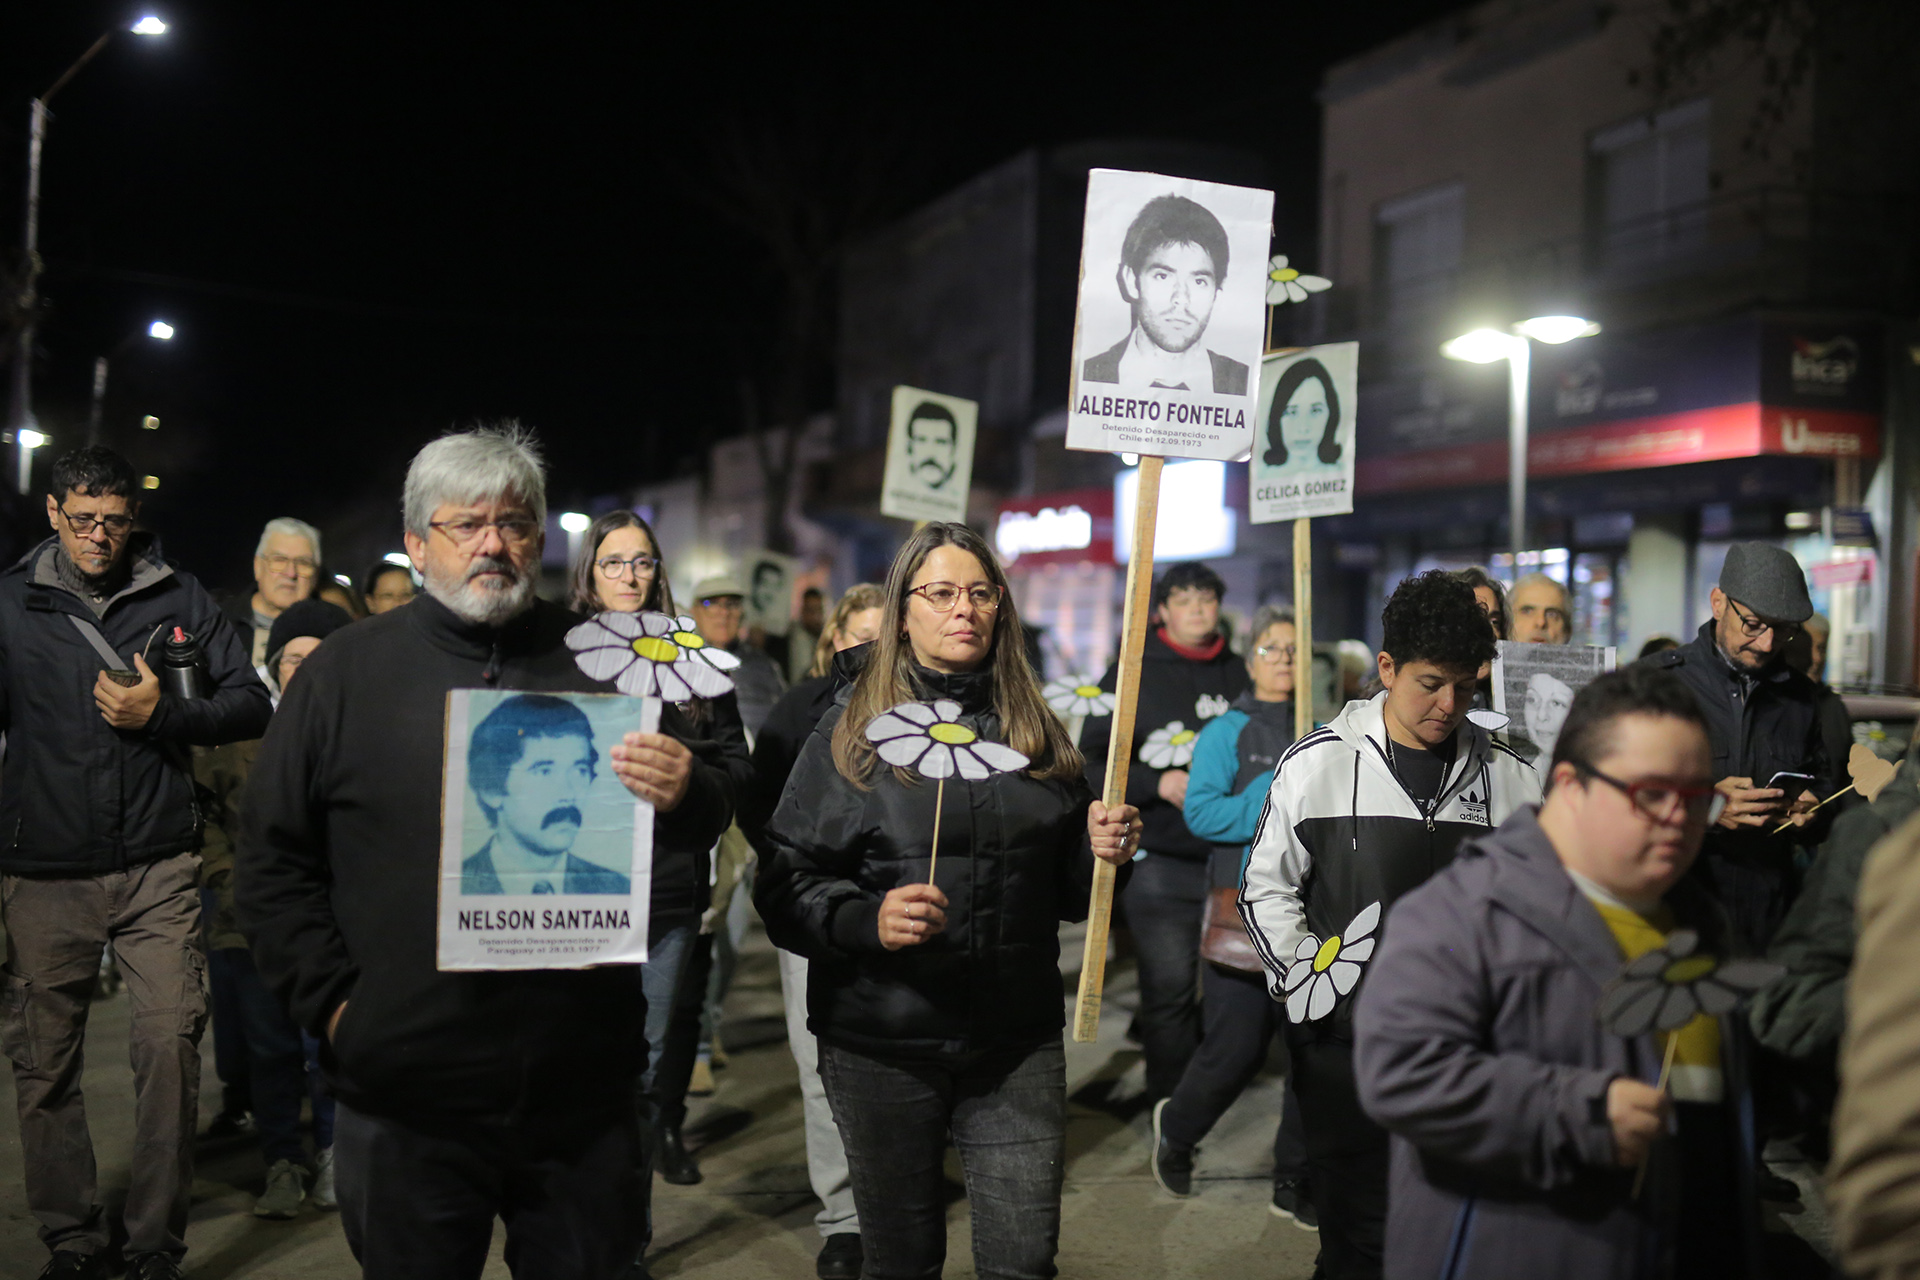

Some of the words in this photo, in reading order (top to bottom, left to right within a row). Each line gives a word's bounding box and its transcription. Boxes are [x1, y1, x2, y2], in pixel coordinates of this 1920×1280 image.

[1078, 395, 1161, 421] ALBERTO
[1166, 402, 1246, 429] FONTELA
[1102, 423, 1143, 434] Detenido
[1145, 427, 1207, 440] Desaparecido
[1208, 433, 1220, 441] en
[1119, 433, 1142, 443] Chile
[1144, 435, 1153, 443] el
[1156, 436, 1202, 447] 12.09.1973
[1256, 483, 1301, 501] CÉLICA
[1304, 479, 1347, 496] GÓMEZ
[458, 910, 535, 931] NELSON
[542, 910, 631, 930] SANTANA
[478, 937, 523, 946] Detenido
[526, 937, 594, 947] Desaparecido
[487, 946, 533, 955] Paraguay
[537, 946, 546, 954] el
